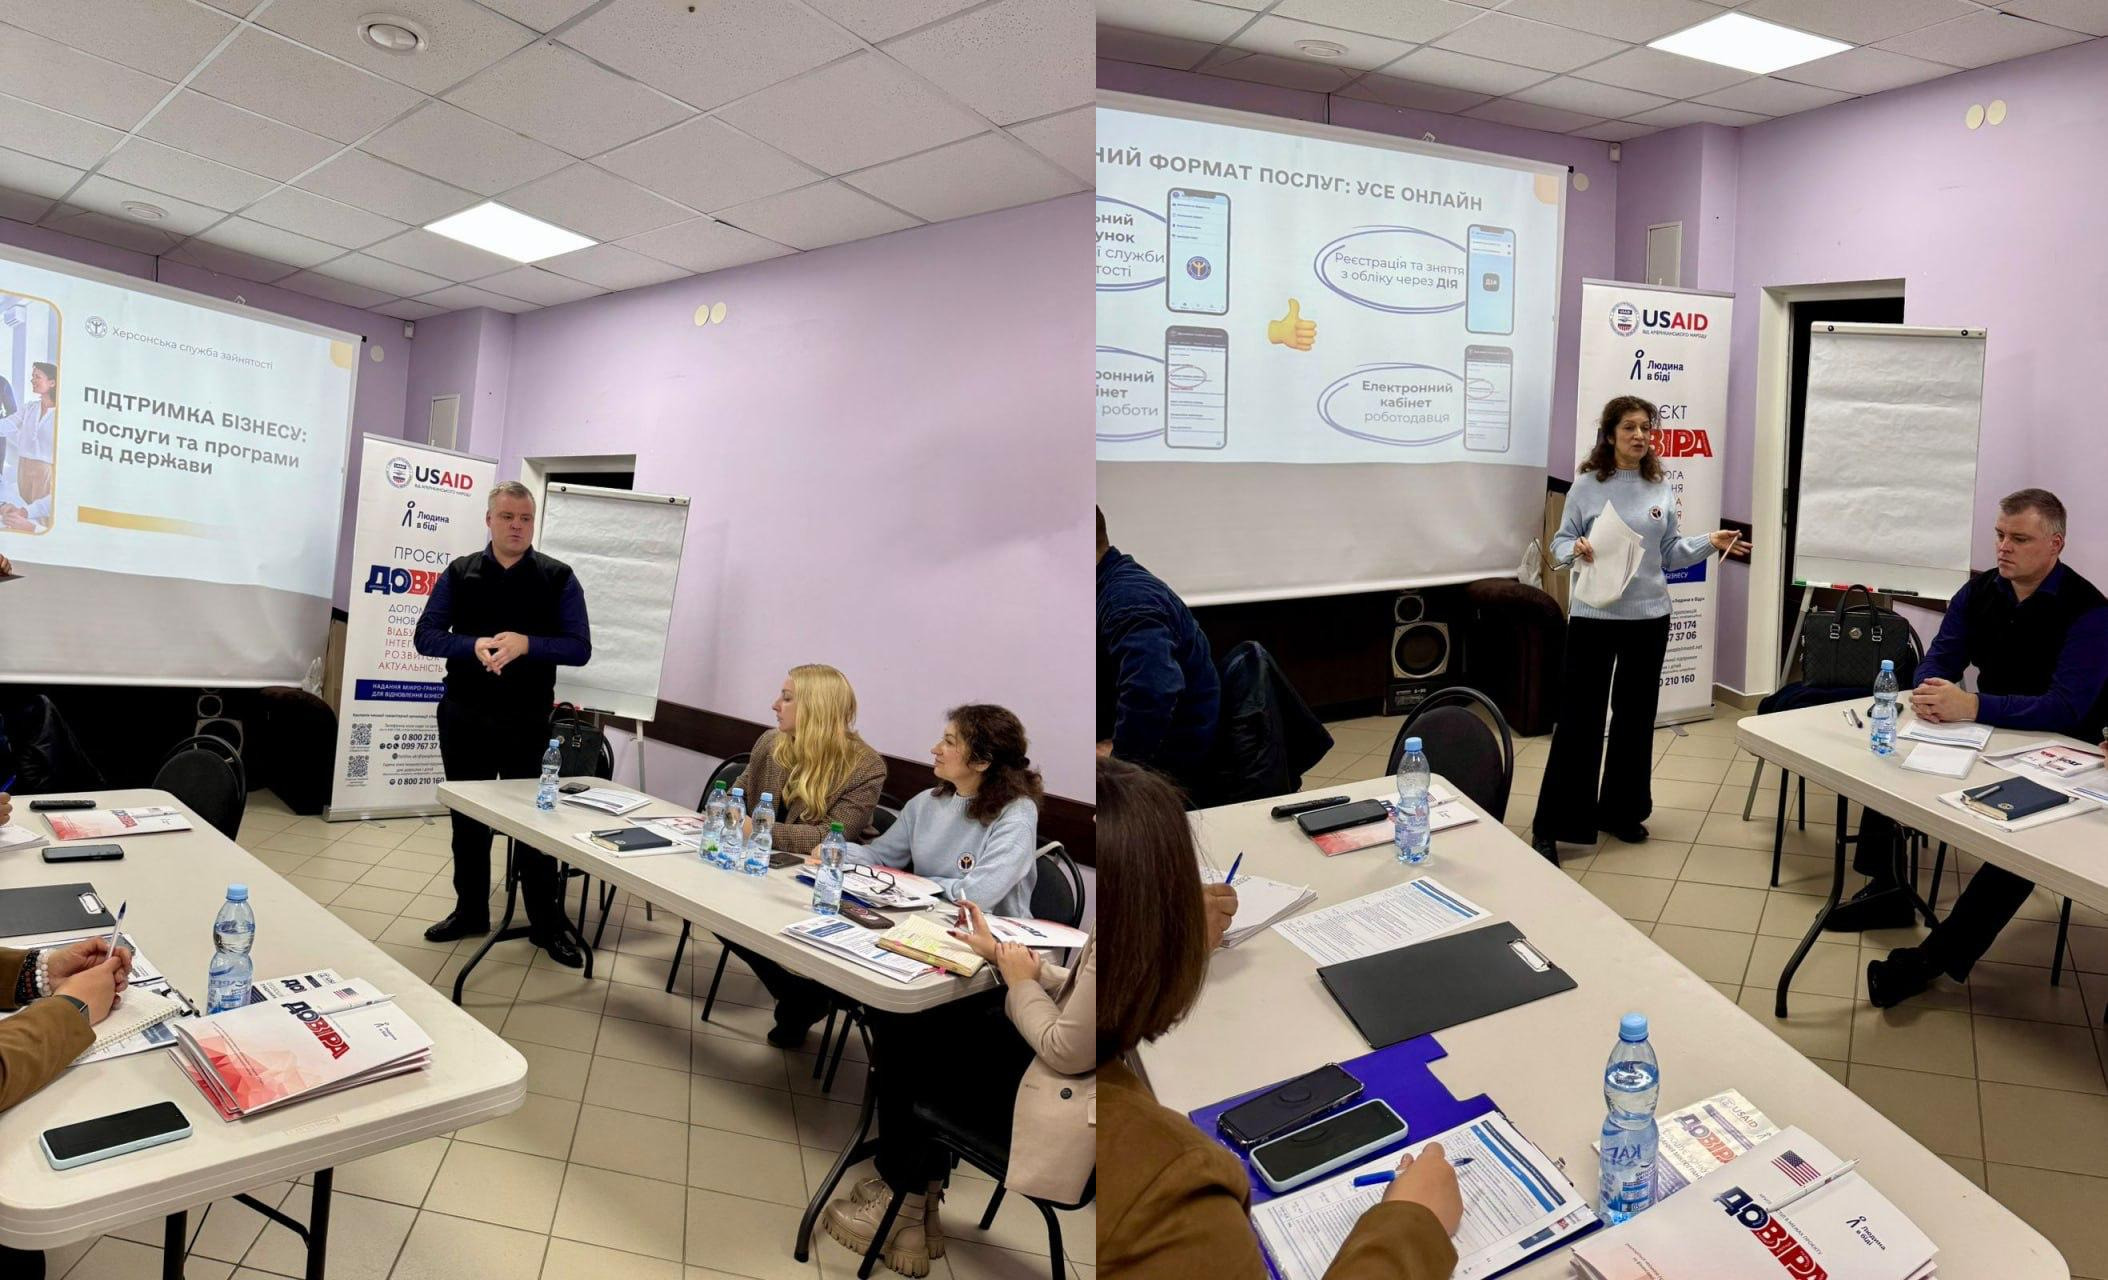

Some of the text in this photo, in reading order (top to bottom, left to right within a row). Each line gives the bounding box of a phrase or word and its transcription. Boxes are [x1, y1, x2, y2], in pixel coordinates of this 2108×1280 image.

[1149, 154, 1252, 180] ФОРМАТ
[1259, 167, 1351, 194] ПОСЛУГ:
[1357, 181, 1395, 200] УСЕ
[1401, 187, 1482, 211] ОНЛАЙН
[1105, 249, 1165, 263] служби
[1335, 253, 1407, 270] Реєстрація
[1411, 261, 1423, 271] та
[1426, 263, 1465, 276] зняття
[1340, 270, 1348, 279] з
[1351, 270, 1393, 286] обліку
[1396, 276, 1434, 288] через
[1642, 309, 1708, 331] USAID
[112, 326, 177, 349] Херсонська
[179, 342, 218, 358] служба
[220, 351, 273, 370] зайнятості
[1647, 360, 1684, 371] Людина
[1654, 371, 1671, 382] біді
[1362, 380, 1453, 395] Електронний
[1380, 397, 1432, 408] кабінет
[84, 386, 307, 443] ПІДТРИМКА БІЗНЕСУ:
[1102, 403, 1159, 417] роботи
[1659, 404, 1688, 420] ЄКТ
[1364, 411, 1450, 424] роботодавця
[82, 419, 300, 468] послуги та програми
[81, 440, 213, 475] від держави
[415, 465, 473, 490] USAID
[417, 511, 450, 524] Людина
[422, 521, 438, 531] біді
[394, 546, 451, 565] ПРОЄКТ
[364, 564, 442, 596] ДОВІ
[1683, 620, 1697, 630] 174
[385, 638, 415, 648] ІНТЕГ
[1675, 632, 1685, 642] 37
[1686, 630, 1697, 640] 06
[378, 661, 444, 673] АКТУАЛЬНІСТЬ
[1665, 676, 1679, 686] 210
[1680, 673, 1695, 684] 160
[401, 733, 436, 741] 0 800 210
[401, 742, 438, 750] 099 767 37
[403, 777, 418, 785] 800
[419, 777, 431, 785] 210
[281, 1001, 351, 1060] ДОВІРА
[1732, 1105, 1758, 1128] USAID
[1673, 1113, 1737, 1164] ДОВІР
[1860, 1233, 1874, 1246] біді
[1861, 1226, 1886, 1250] Людина
